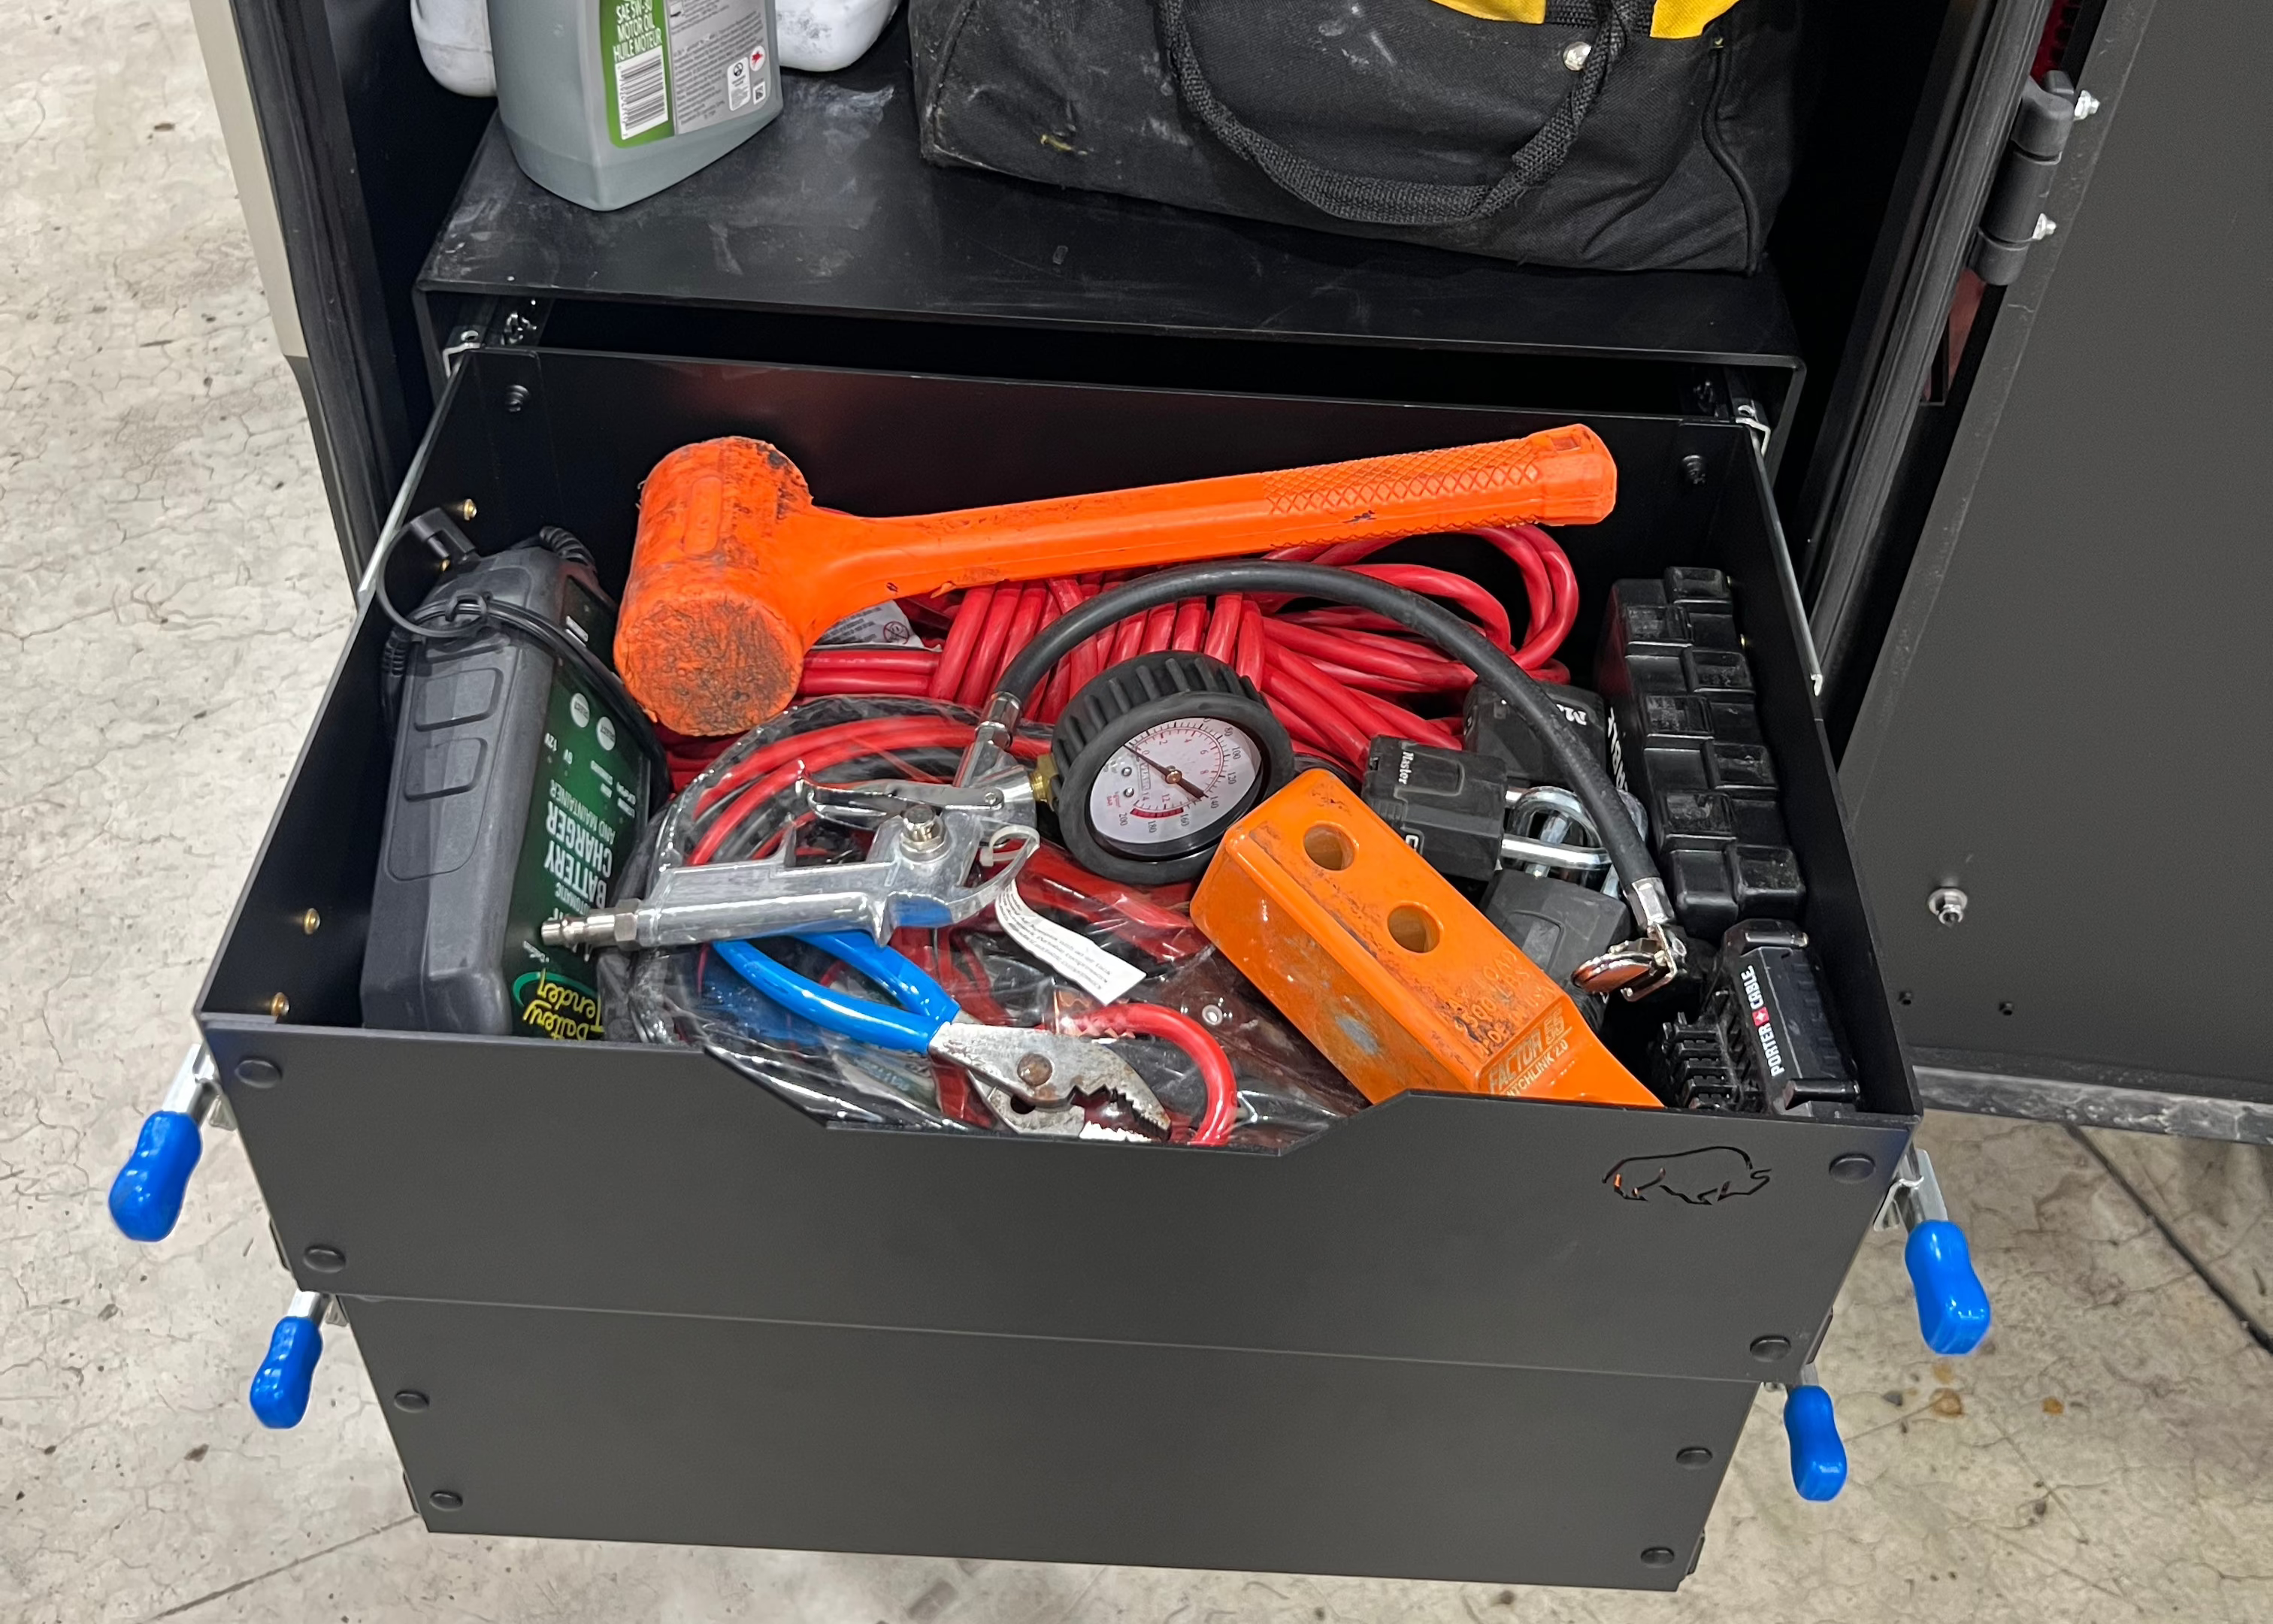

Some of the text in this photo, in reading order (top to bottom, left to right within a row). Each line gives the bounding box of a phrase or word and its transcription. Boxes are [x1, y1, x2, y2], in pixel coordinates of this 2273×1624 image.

[616, 2, 631, 24] SAE
[617, 17, 644, 42] MOTOR
[643, 12, 655, 31] OIL
[613, 27, 662, 63] HUILE MOTEUR
[1231, 746, 1242, 760] 100
[1398, 752, 1415, 785] Master
[1227, 772, 1237, 785] 120
[549, 779, 598, 832] MAINTAINER
[1210, 796, 1219, 809] 140
[598, 820, 616, 845] AND
[1118, 812, 1128, 827] 200
[1180, 813, 1190, 827] 160
[546, 800, 613, 879] CHARGER
[543, 839, 607, 909] BATTERY
[554, 882, 592, 916] UTOMATIC
[537, 967, 605, 1033] Tender
[1740, 965, 1785, 1077] PORTER CABLE
[1489, 1027, 1543, 1095] FACTOR
